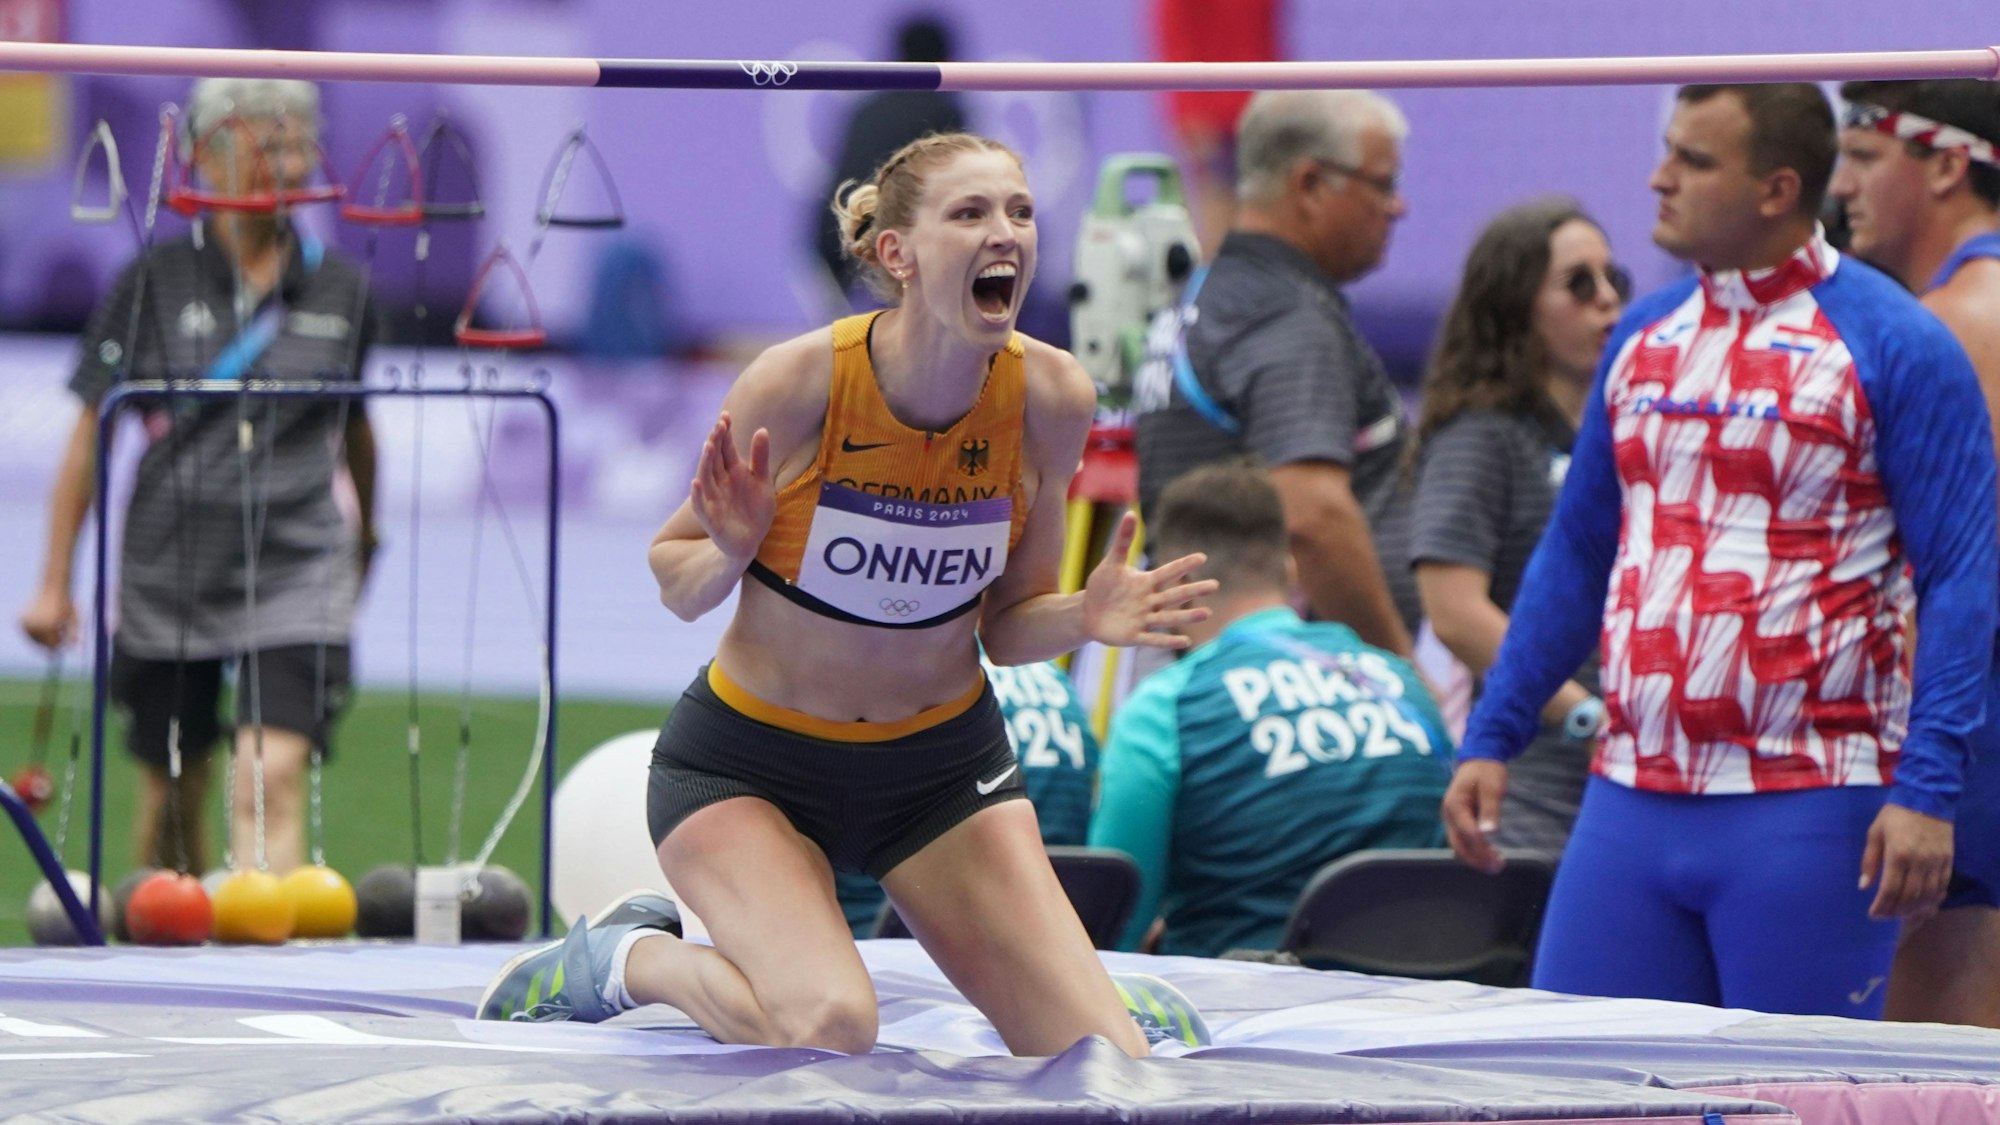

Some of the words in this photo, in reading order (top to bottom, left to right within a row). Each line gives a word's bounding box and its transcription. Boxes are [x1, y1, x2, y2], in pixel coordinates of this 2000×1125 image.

[873, 502, 924, 519] PARIS
[929, 508, 969, 521] 2024
[824, 536, 993, 586] ONNEN
